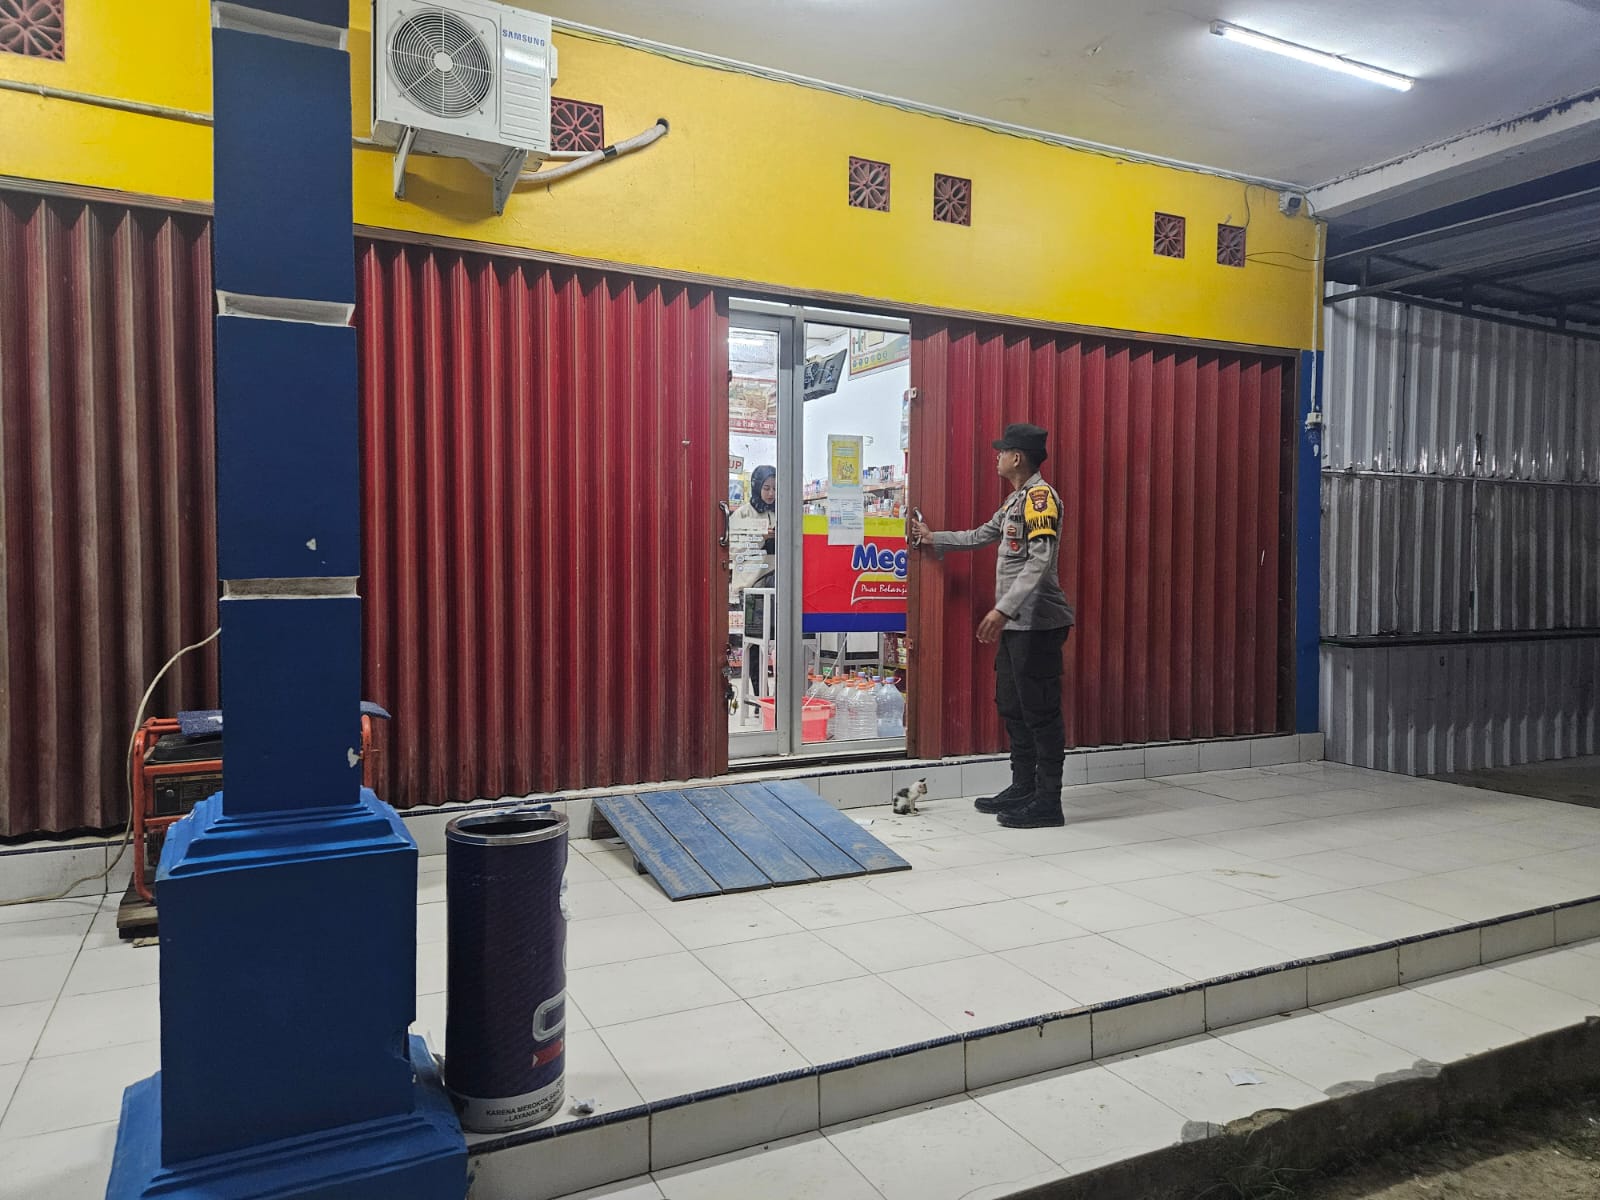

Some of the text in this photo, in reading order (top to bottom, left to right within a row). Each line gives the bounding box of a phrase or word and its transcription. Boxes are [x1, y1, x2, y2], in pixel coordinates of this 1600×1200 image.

[502, 29, 545, 47] SAMSUNG
[852, 543, 907, 578] Meg
[486, 1108, 516, 1116] KARENA
[516, 1097, 549, 1113] MEROKOK
